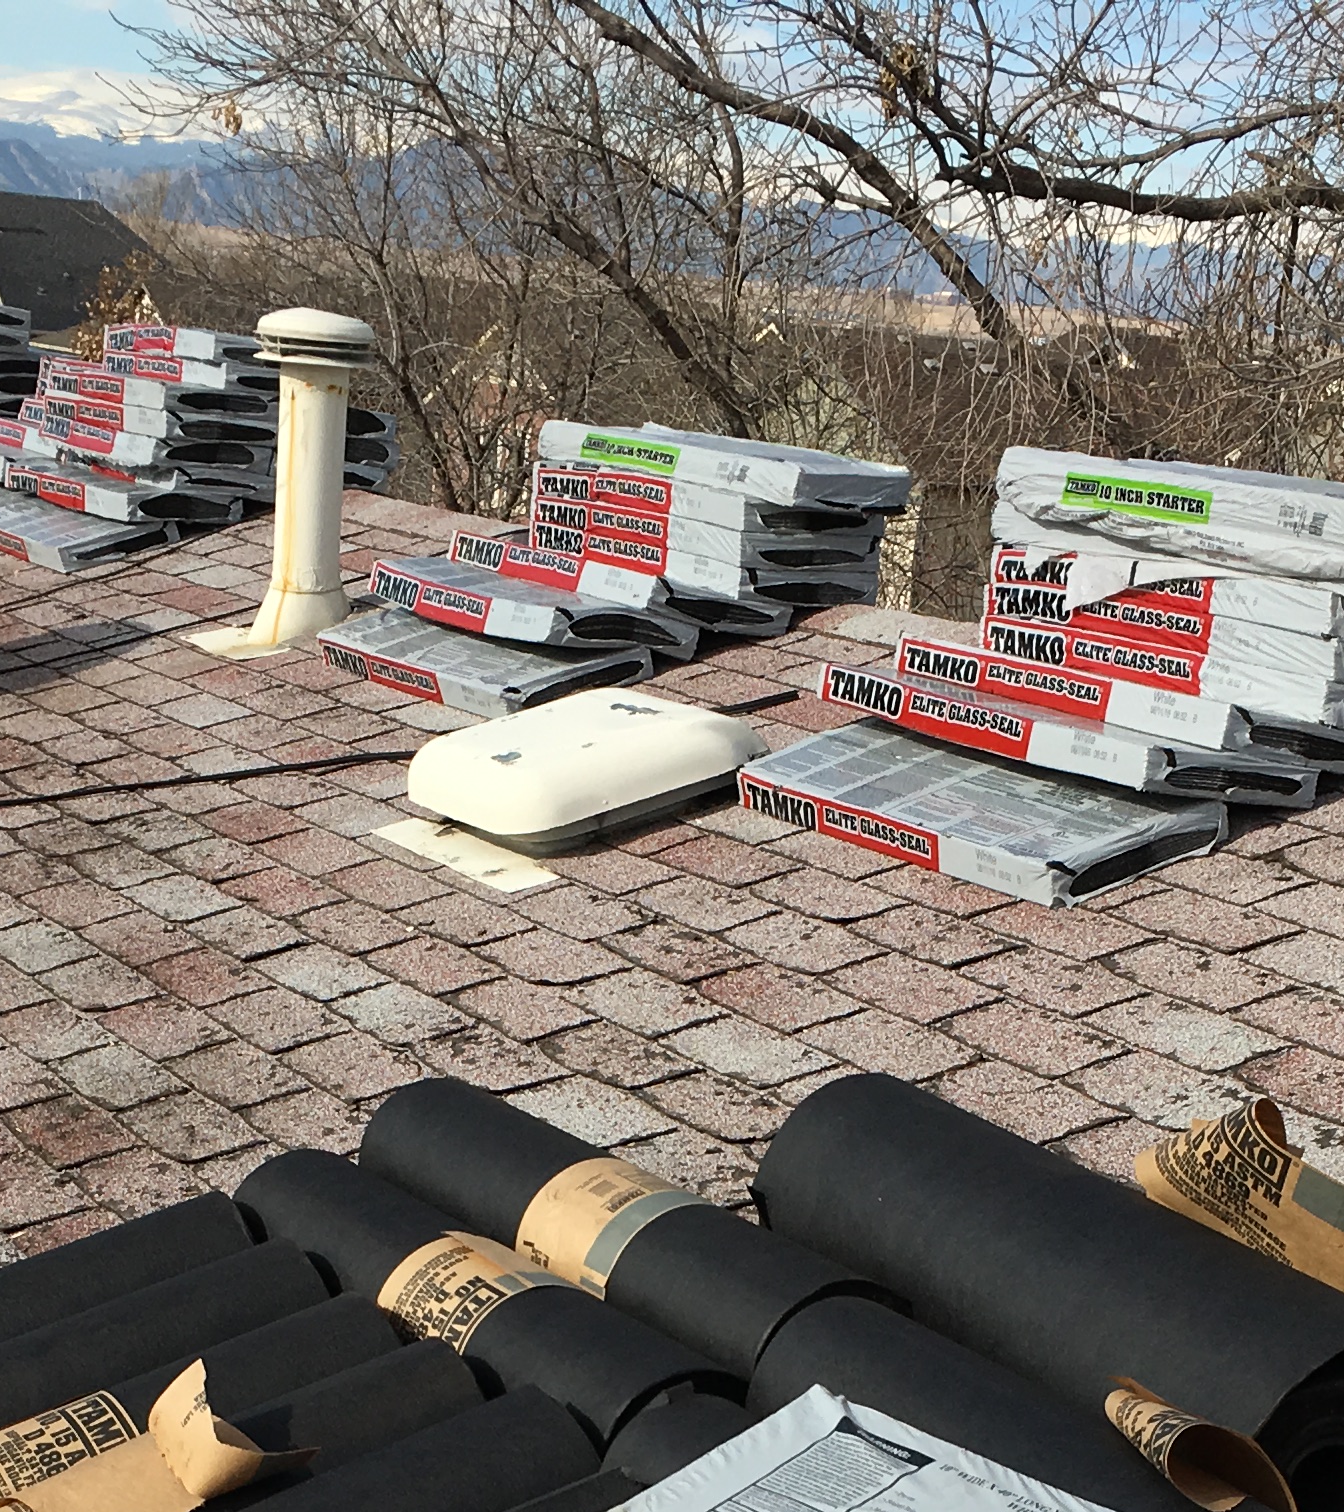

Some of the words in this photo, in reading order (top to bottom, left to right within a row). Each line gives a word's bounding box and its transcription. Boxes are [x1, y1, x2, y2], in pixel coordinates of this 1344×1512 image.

[636, 448, 675, 465] STARTER
[542, 476, 588, 499] TAMKO
[619, 482, 665, 502] GLASS-SEAL
[1069, 480, 1098, 493] TAMKO
[1099, 485, 1111, 499] 10
[1114, 487, 1143, 504] INCH
[1147, 491, 1205, 514] STARTER
[540, 504, 587, 530] TAMKO
[616, 514, 662, 536] GLASS-SEAL
[457, 536, 504, 569] TAMKO
[509, 547, 530, 563] ELITE
[531, 552, 577, 574] GLASS-SEAL
[536, 525, 583, 555] TAMKO
[613, 540, 660, 562] GLASS-SEAL
[376, 570, 419, 609] TAMKO
[444, 593, 484, 616] GLASS-SEAL
[1081, 600, 1118, 620] ELITE
[1121, 605, 1201, 635] GLASS-SEAL
[323, 645, 368, 680] TAMKO
[990, 625, 1065, 666] TAMKO
[1074, 641, 1111, 662] ELITE
[1113, 648, 1191, 679] GLASS-SEAL
[906, 646, 978, 684] TAMKO
[988, 664, 1022, 684] ELITE
[1025, 673, 1099, 703] GLASS-SEAL
[830, 669, 903, 718] TAMKO
[910, 695, 945, 718] ELITE
[948, 704, 1022, 738] GLASS-SEAL
[747, 782, 816, 831] TAMKO
[824, 807, 858, 832] ELITE
[860, 818, 930, 856] GLASS-SEAL
[1202, 1150, 1251, 1200] 4869
[1223, 1151, 1284, 1209] ASTM
[22, 1428, 46, 1442] D
[50, 1426, 76, 1448] 15
[6, 1467, 24, 1492] ROLL
[957, 1471, 990, 1488] WIDE
[1017, 1495, 1052, 1512] LONG
